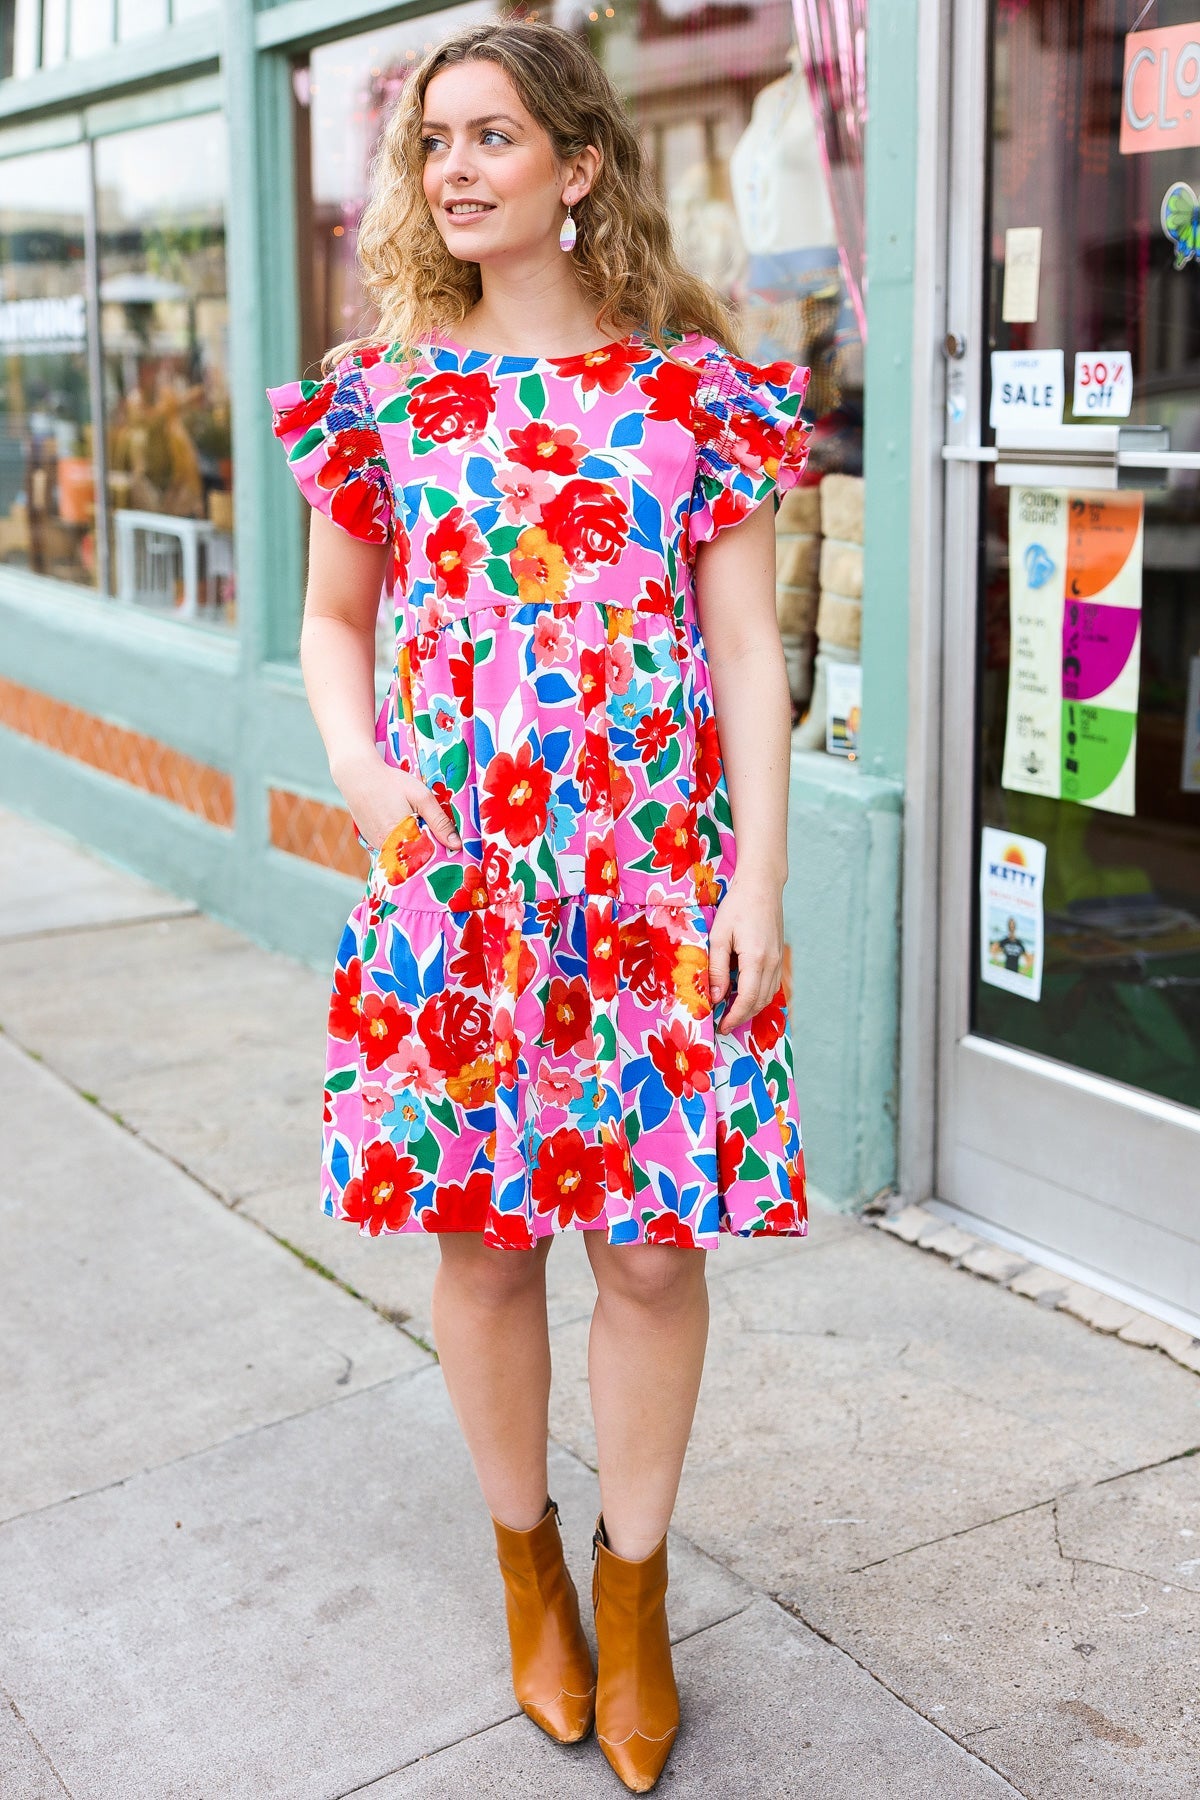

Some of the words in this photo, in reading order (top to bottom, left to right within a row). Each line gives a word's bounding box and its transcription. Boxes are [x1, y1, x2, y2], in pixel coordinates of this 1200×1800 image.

[1080, 363, 1125, 385] 30%
[1002, 383, 1054, 406] SALE
[1087, 384, 1113, 408] off
